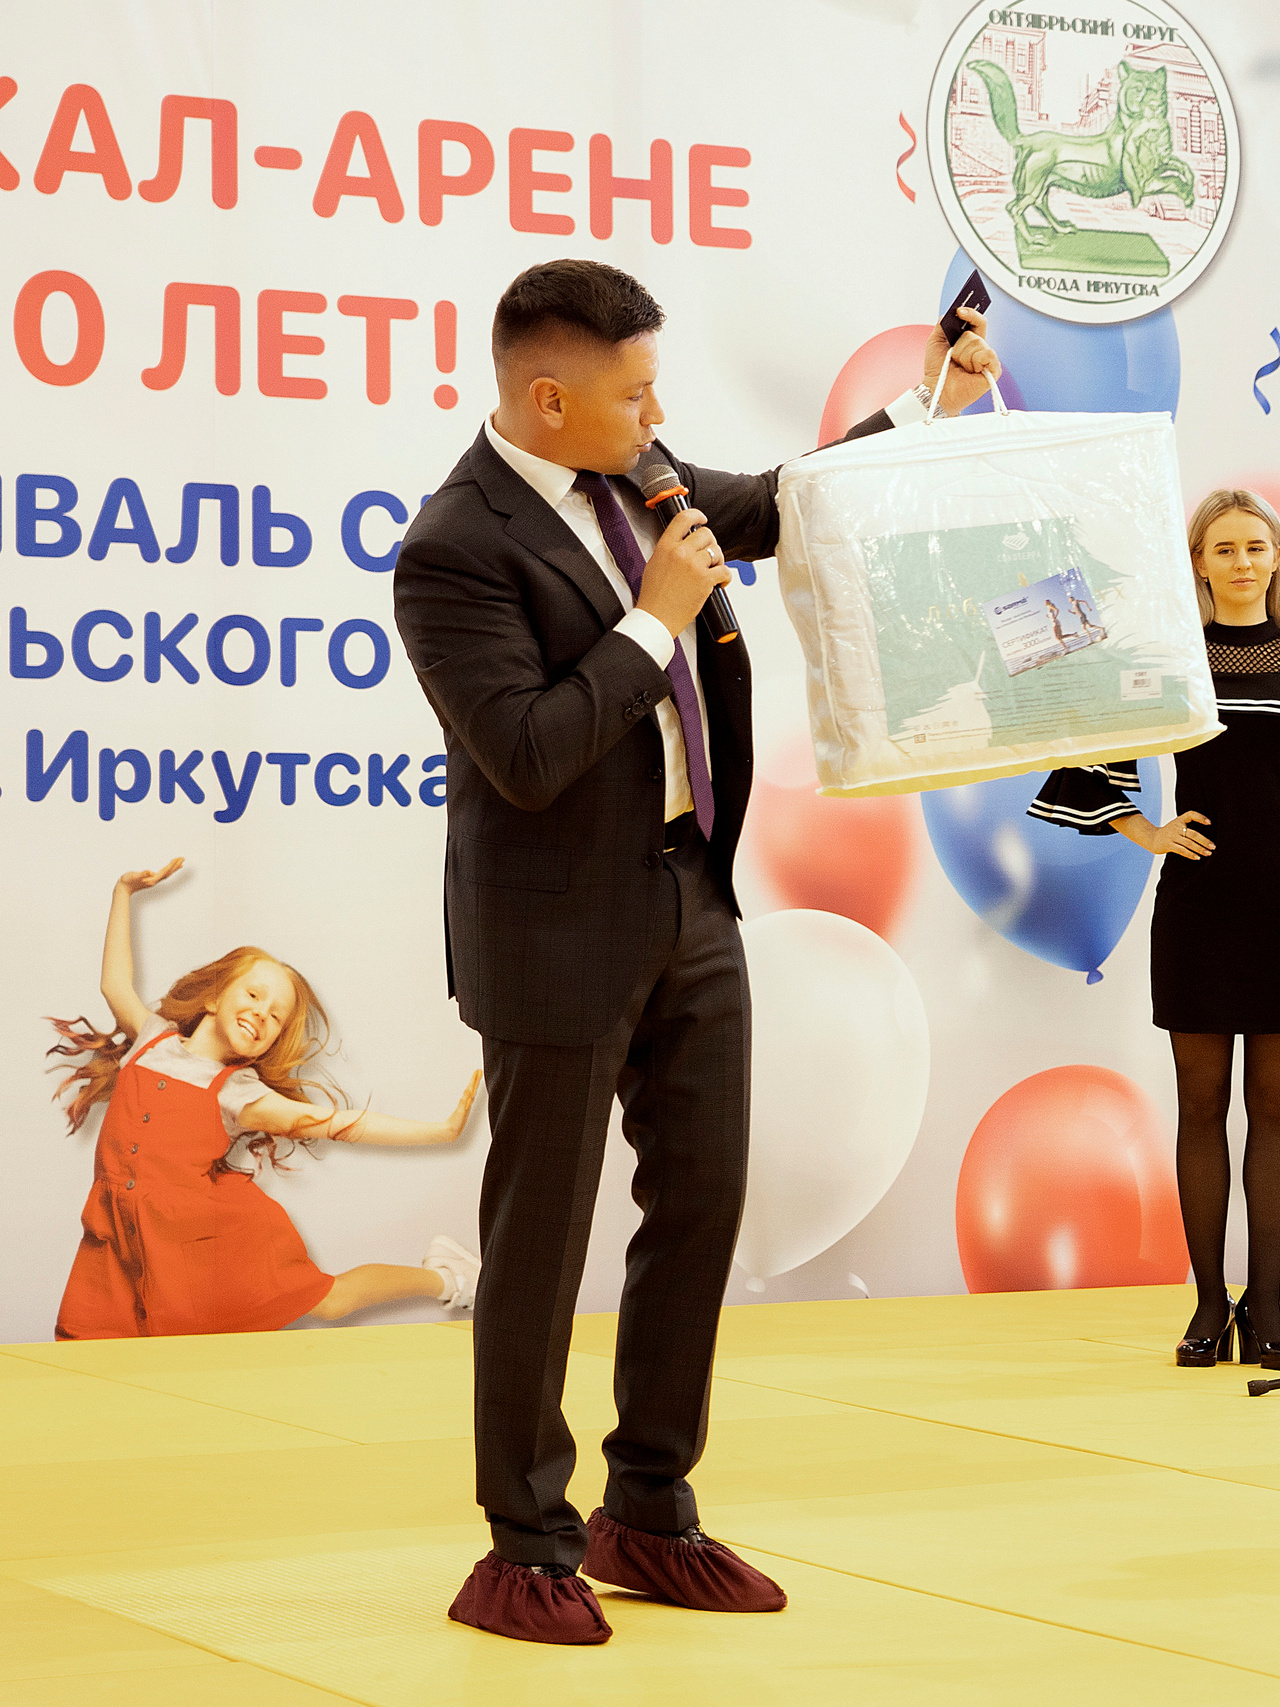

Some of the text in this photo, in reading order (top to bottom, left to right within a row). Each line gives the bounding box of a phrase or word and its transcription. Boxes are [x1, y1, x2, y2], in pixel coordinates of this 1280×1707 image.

[988, 9, 1179, 42] ОКТЯБРЬСКИЙ ОКРУГ
[0, 76, 753, 250] АЛ-АРЕНЕ
[1018, 275, 1160, 297] ГОРОДА ИРКУТСКА
[141, 281, 459, 410] ЛЕТ!
[0, 474, 312, 567] ВАЛЬ
[10, 607, 391, 689] ЬСКОГО
